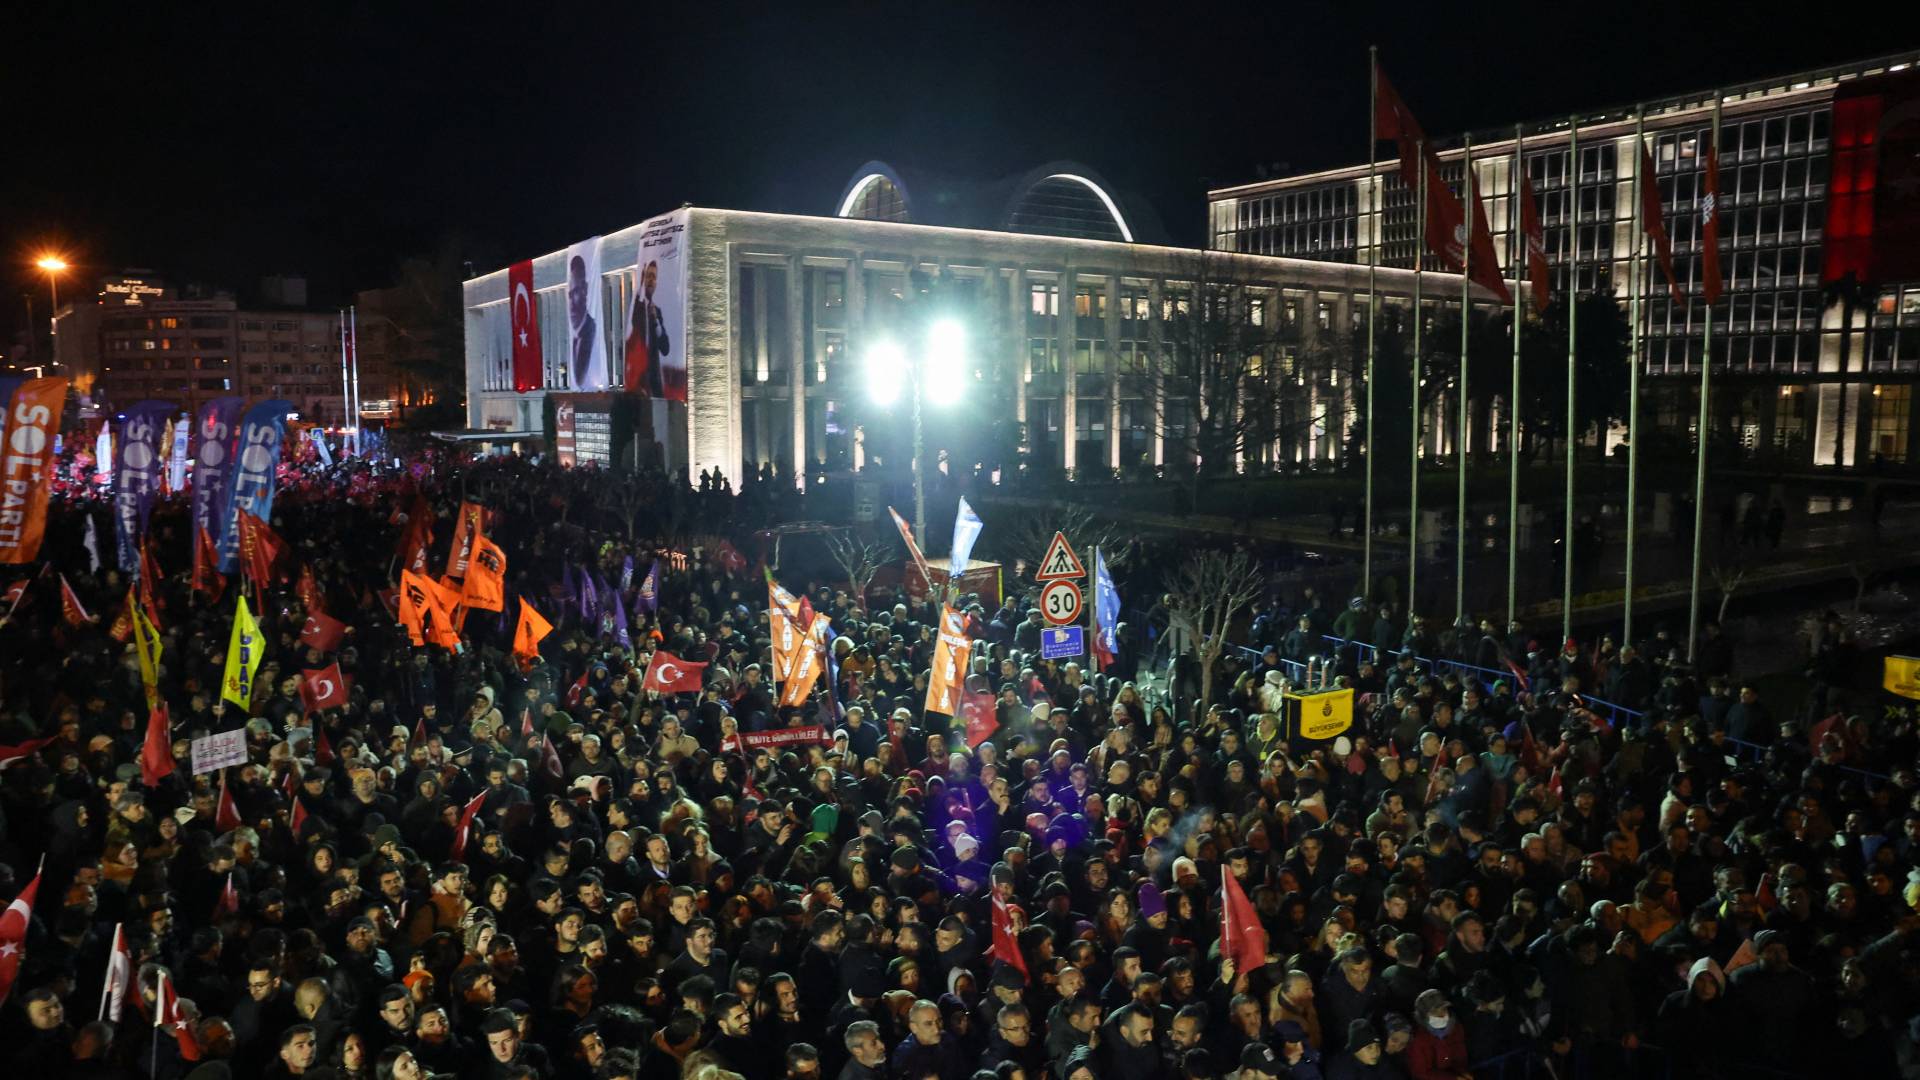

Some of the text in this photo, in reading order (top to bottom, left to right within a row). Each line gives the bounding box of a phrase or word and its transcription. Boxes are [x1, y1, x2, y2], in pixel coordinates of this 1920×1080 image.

[7, 402, 50, 476] SOL
[121, 413, 152, 488] SOL
[200, 419, 228, 489] SOL
[236, 422, 276, 491] SOL
[1050, 592, 1075, 614] 30
